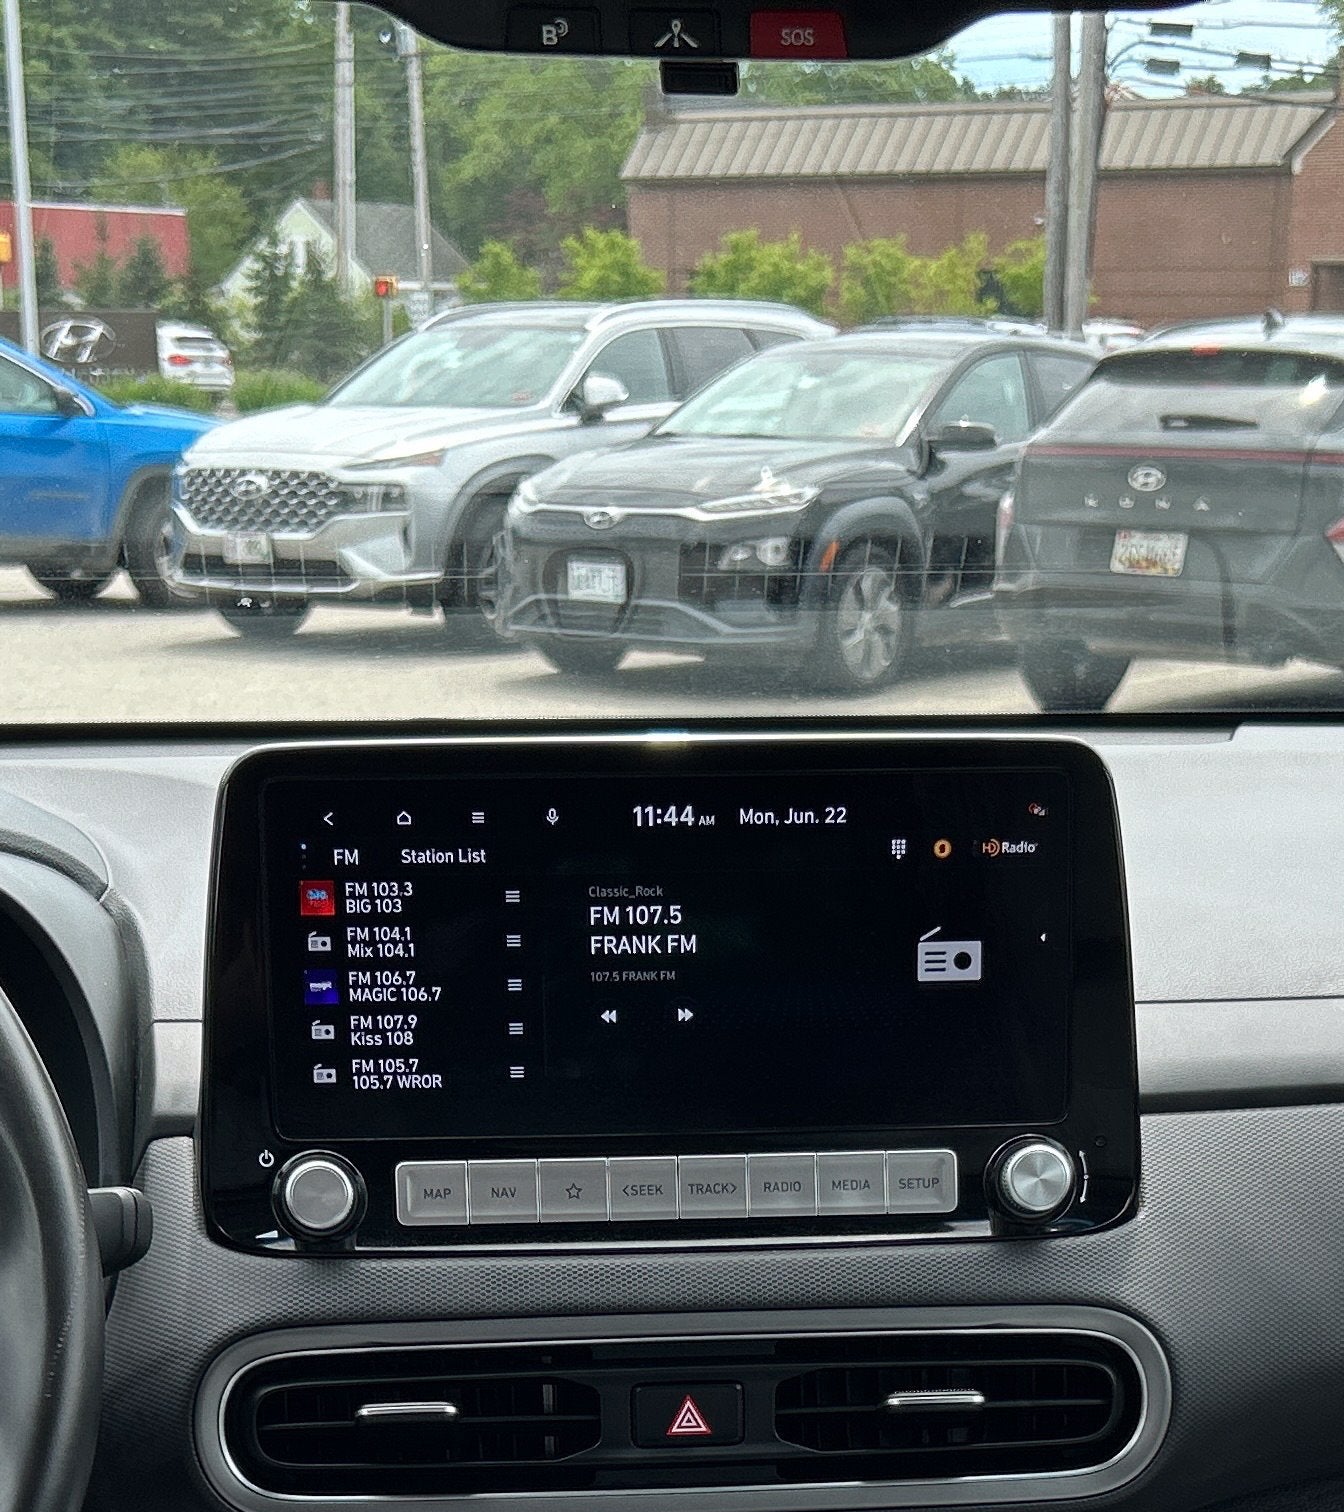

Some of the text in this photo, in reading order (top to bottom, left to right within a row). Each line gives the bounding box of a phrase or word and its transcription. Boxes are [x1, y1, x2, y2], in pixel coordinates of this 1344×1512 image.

[781, 28, 814, 46] SOS
[633, 805, 695, 827] 11:44
[698, 815, 715, 826] AM
[784, 807, 820, 825] Jun.
[825, 806, 847, 823] 22
[1001, 841, 1036, 853] Radio
[333, 849, 359, 865] FM
[401, 848, 486, 865] Station List
[345, 881, 413, 897] FM 103.3
[345, 899, 402, 914] BIG 103
[589, 905, 683, 926] FM 107.5
[346, 926, 411, 942] FM 104.1
[347, 943, 415, 958] Mix 104.1
[589, 934, 697, 955] FRANK FM
[348, 972, 372, 987] FM
[375, 971, 416, 986] 106.7
[590, 970, 676, 983] 107.5 FRANK FM
[349, 987, 442, 1003] MAGIC 106.7
[350, 1015, 418, 1031] FM 107.9
[350, 1031, 414, 1046] Kiss 108
[351, 1059, 419, 1074] FM 105.7
[352, 1074, 443, 1090] 105.7 WROR
[763, 1180, 802, 1193] RADIO
[831, 1178, 871, 1191] MEDIA
[898, 1177, 940, 1190] SETUP
[423, 1186, 452, 1199] MAP
[490, 1186, 517, 1198] NAV
